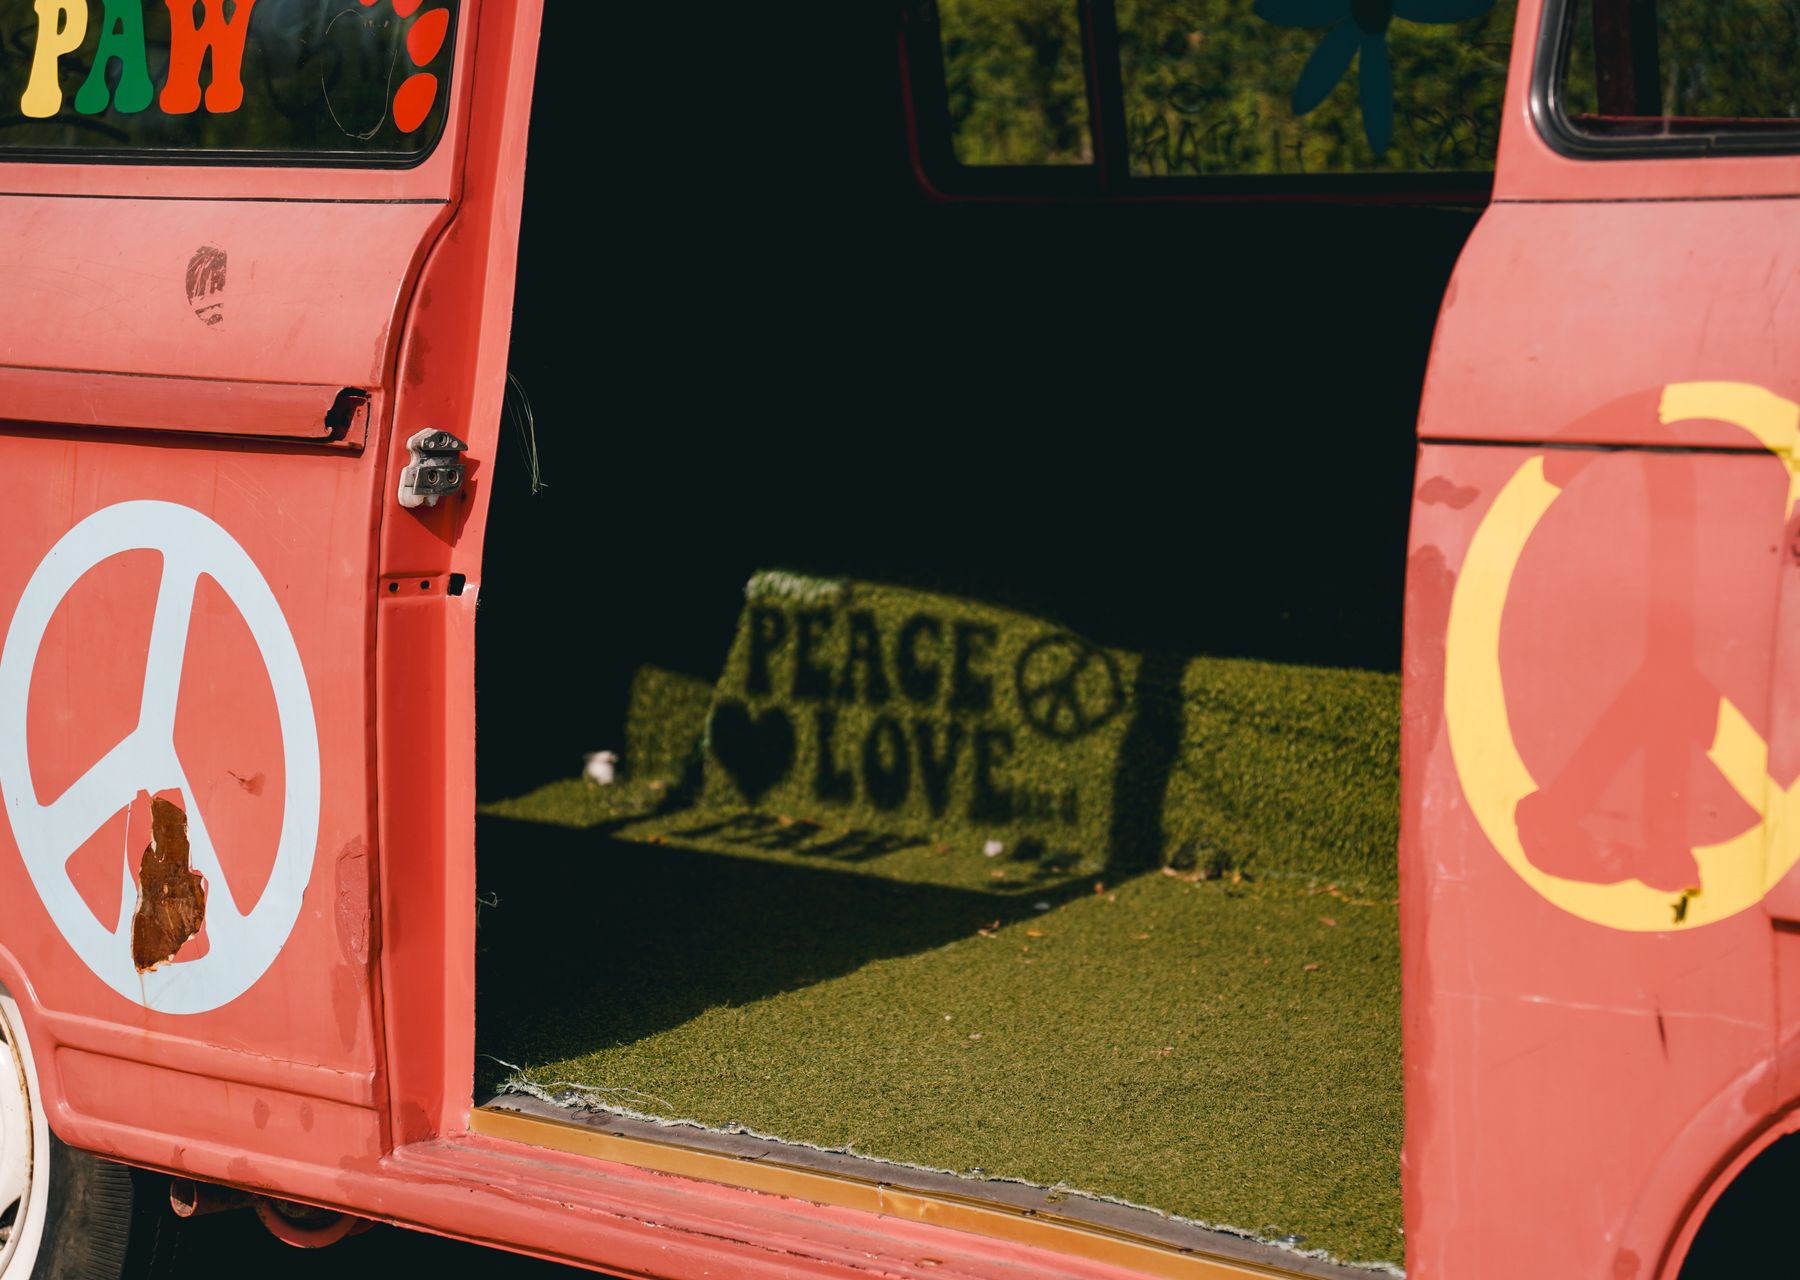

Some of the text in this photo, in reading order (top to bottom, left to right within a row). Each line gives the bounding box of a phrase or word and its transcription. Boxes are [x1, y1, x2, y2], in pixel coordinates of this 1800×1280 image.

[20, 0, 256, 118] PAW
[747, 605, 999, 710] PEACE
[814, 707, 1015, 824] LOVE
